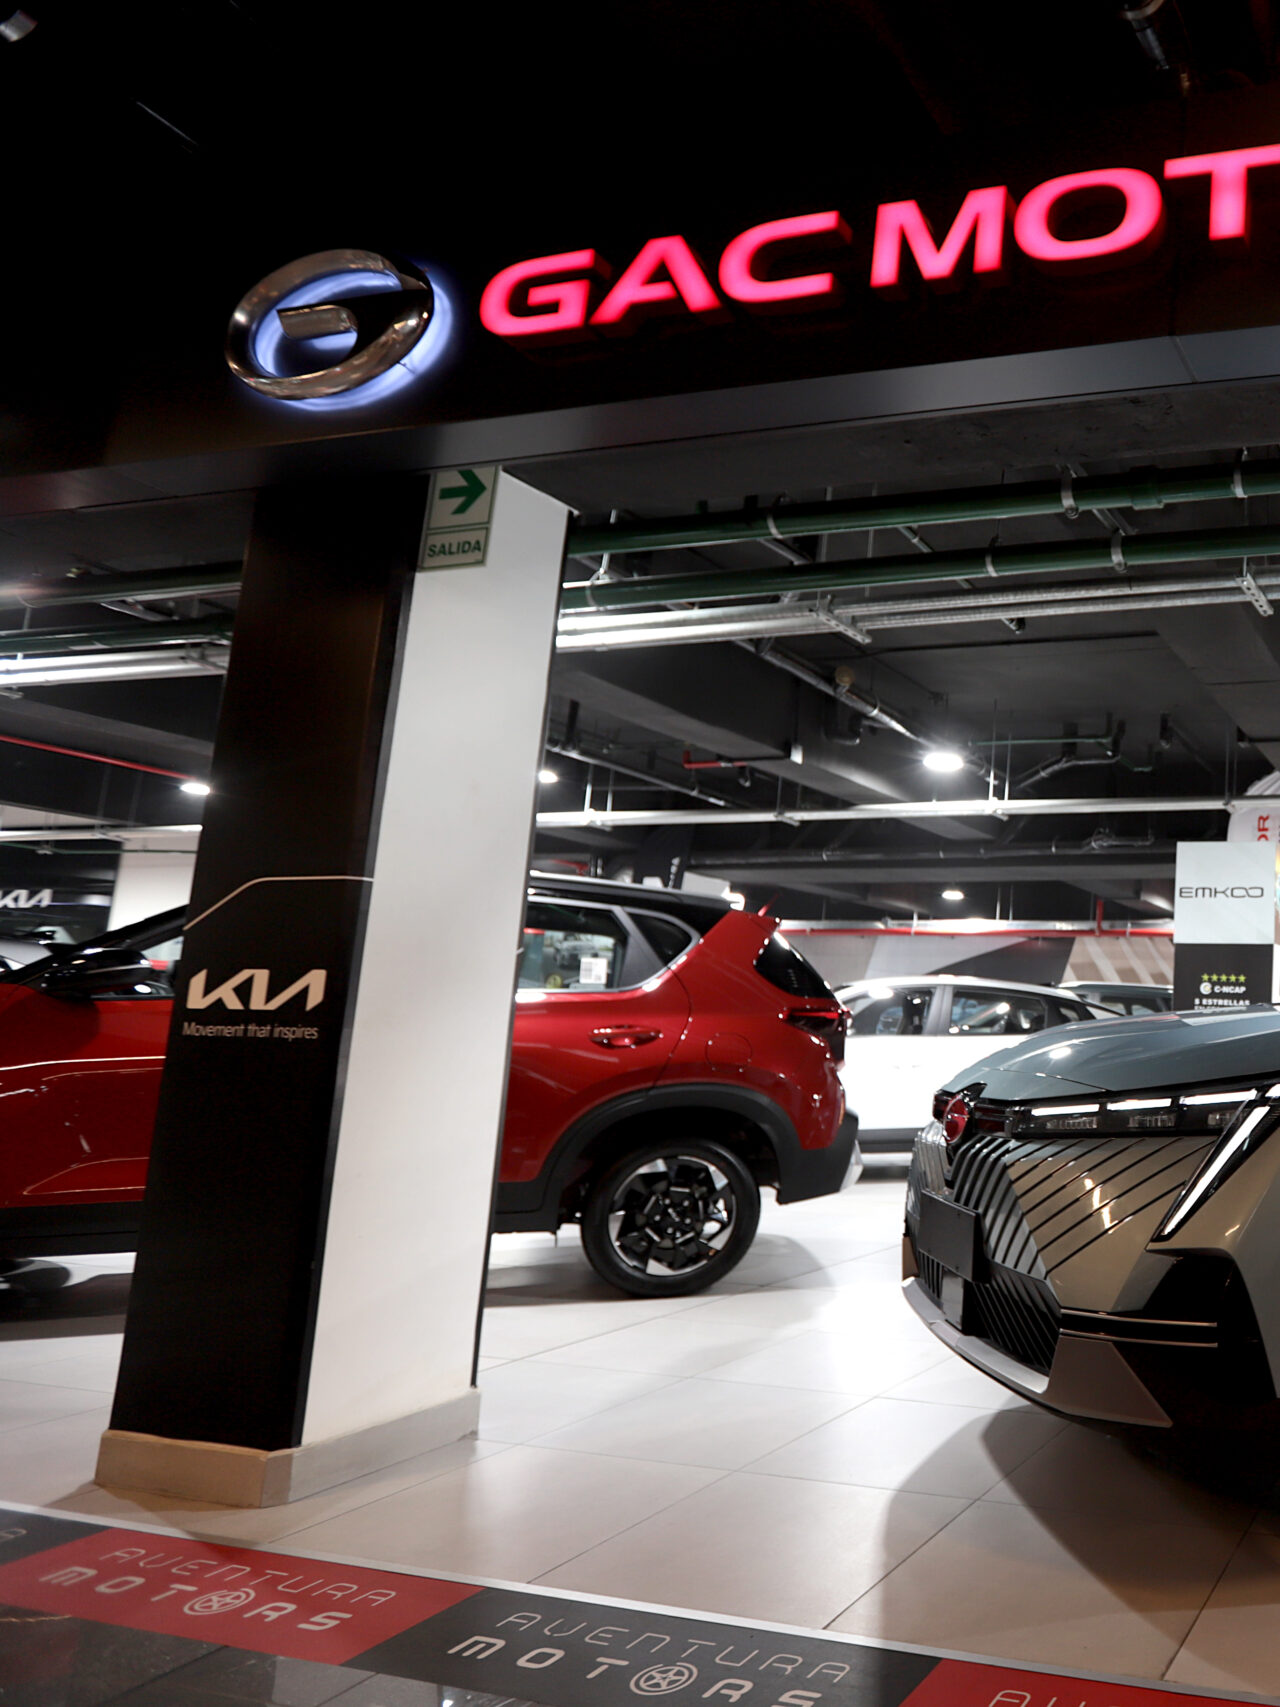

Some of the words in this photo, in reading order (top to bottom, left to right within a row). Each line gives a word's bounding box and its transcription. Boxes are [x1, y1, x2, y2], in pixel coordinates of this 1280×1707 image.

[480, 211, 840, 336] GAC
[427, 540, 482, 558] SALIDA
[186, 968, 327, 1012] KIA
[1202, 998, 1250, 1006] ESTRELLAS
[182, 1021, 244, 1037] Movement
[247, 1022, 271, 1037] that
[273, 1024, 319, 1042] inspires
